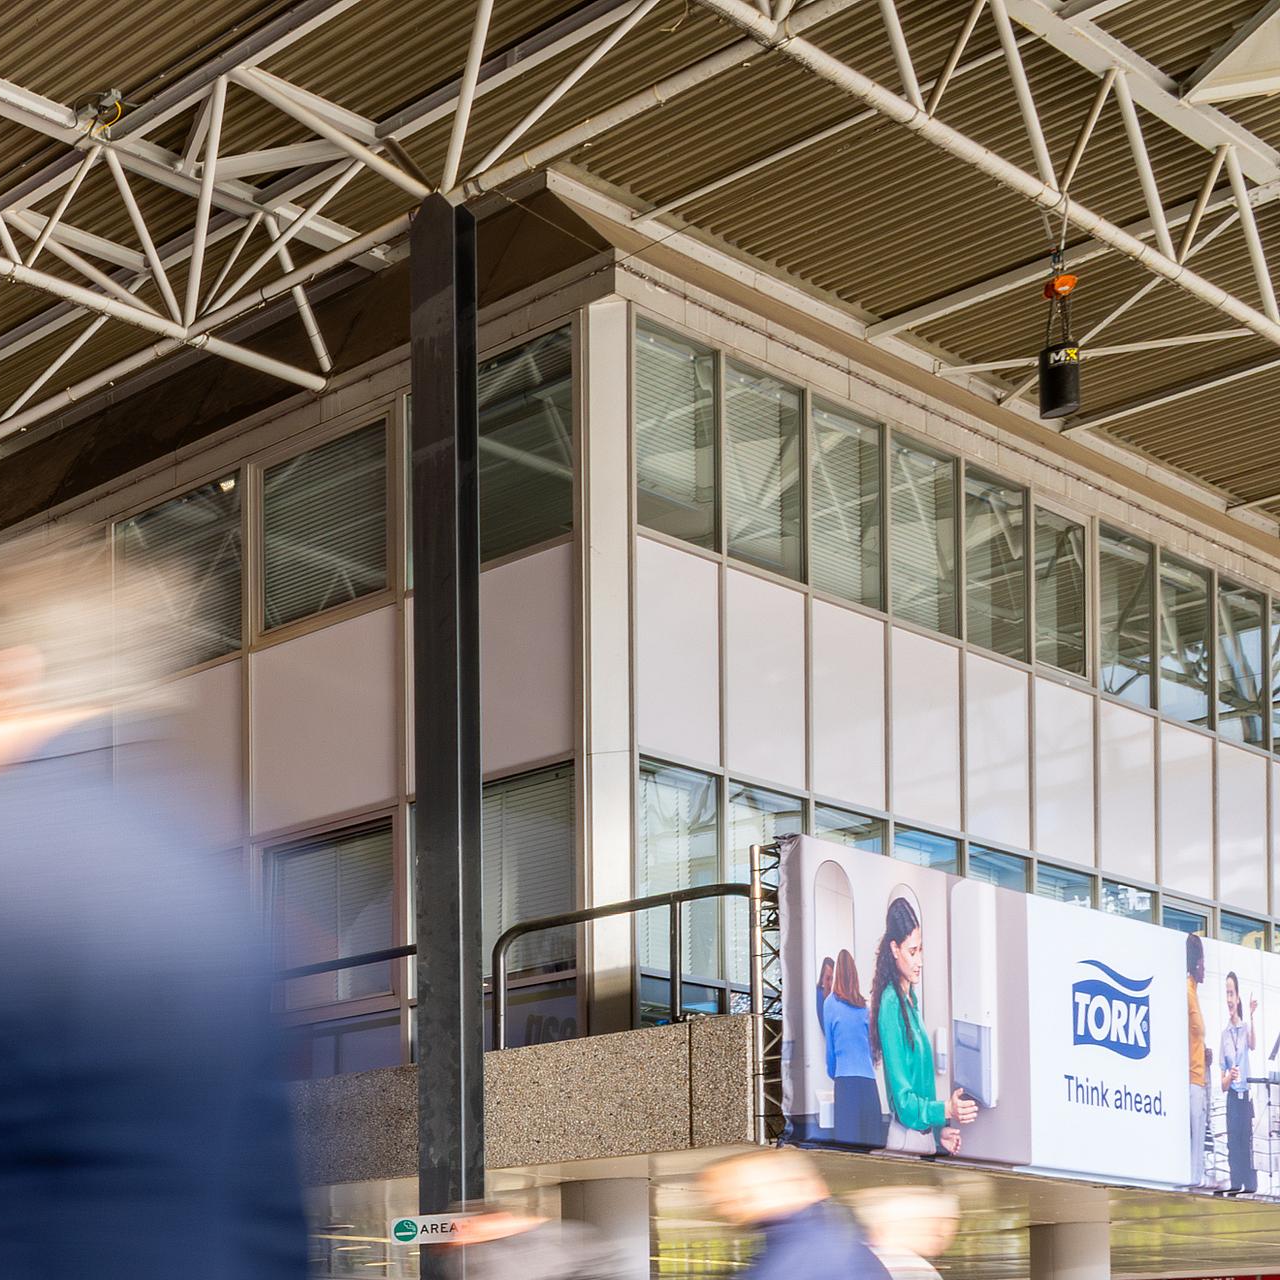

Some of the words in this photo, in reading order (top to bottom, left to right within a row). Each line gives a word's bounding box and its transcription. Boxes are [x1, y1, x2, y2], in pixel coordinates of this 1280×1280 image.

[1050, 348, 1078, 364] MX
[1074, 991, 1149, 1048] TORK
[1064, 1074, 1110, 1108] Think
[1114, 1084, 1167, 1117] ahead.
[420, 1222, 459, 1235] AREA
